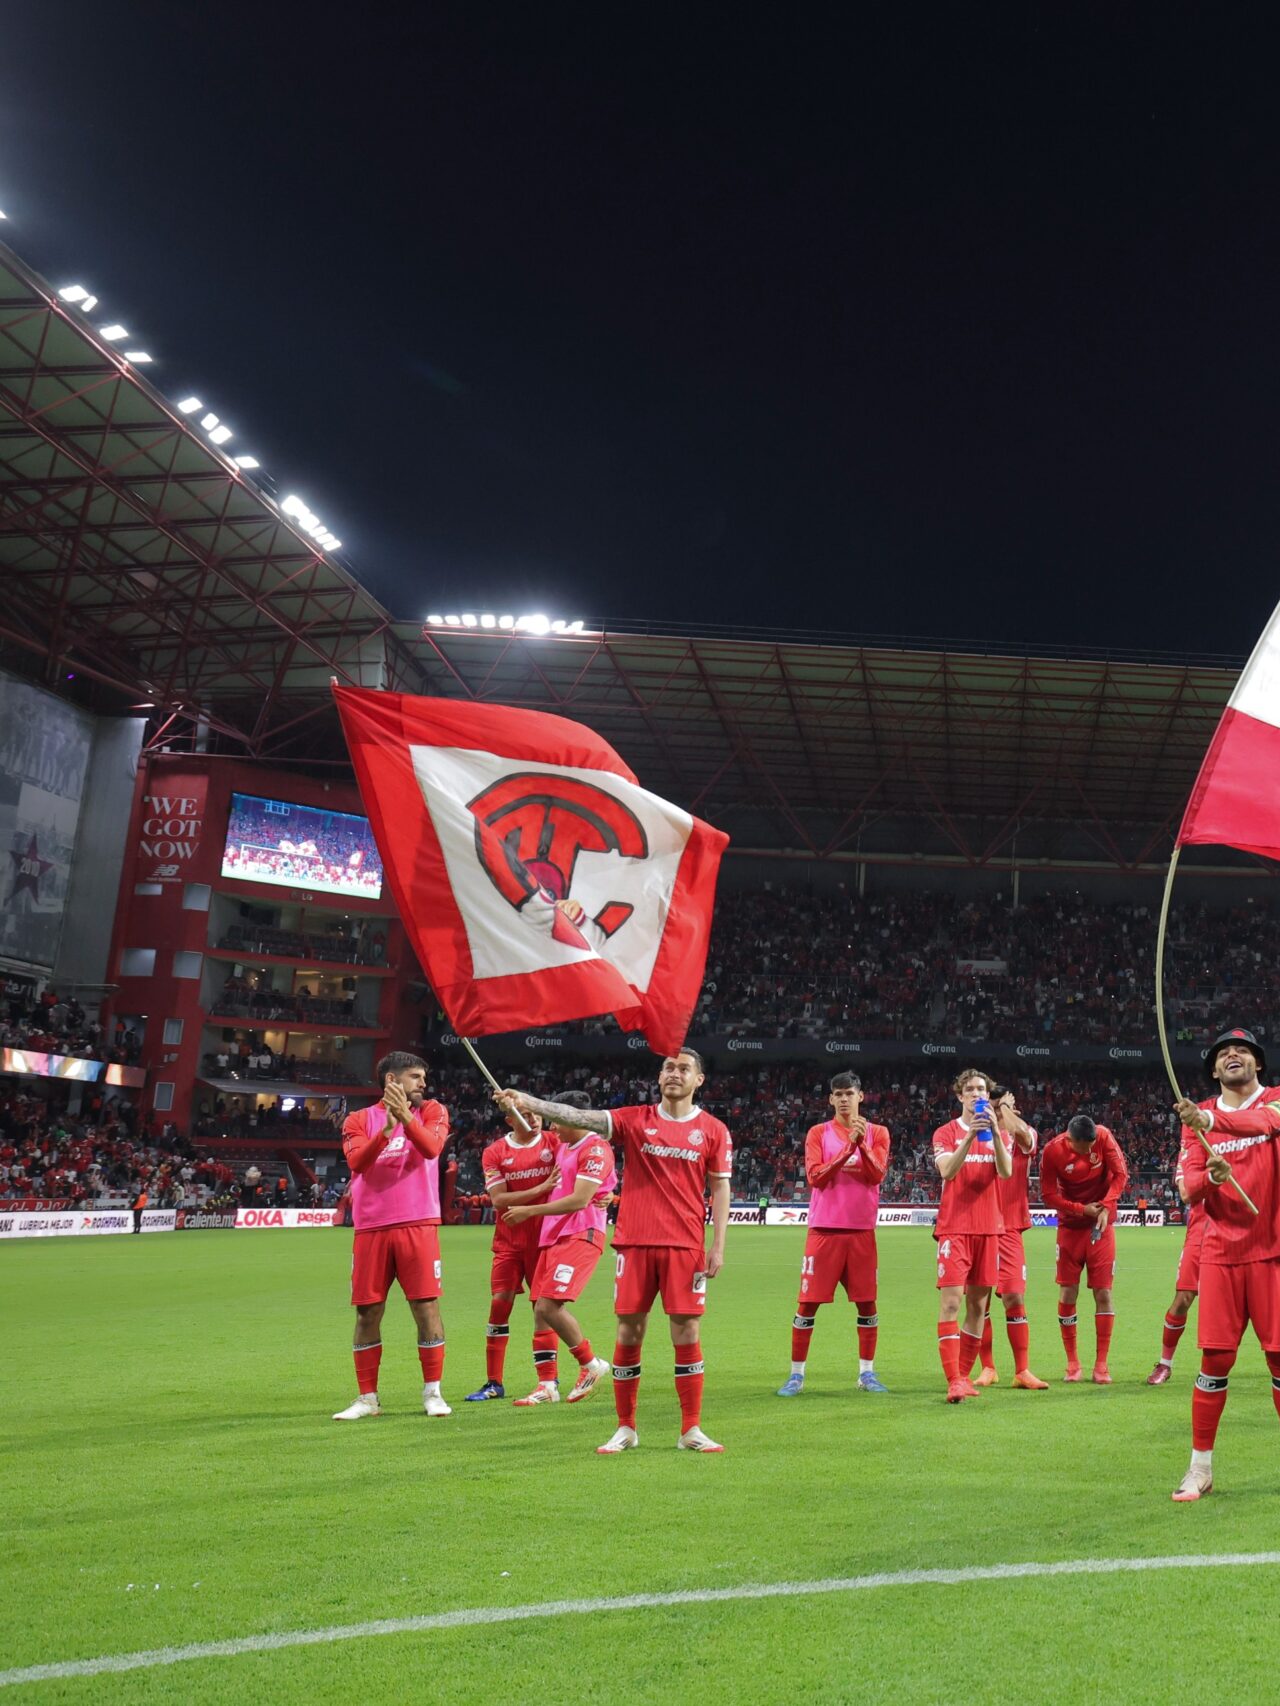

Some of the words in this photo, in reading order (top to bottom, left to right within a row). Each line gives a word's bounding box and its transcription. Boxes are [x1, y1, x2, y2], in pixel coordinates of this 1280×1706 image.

[150, 796, 198, 816] WE
[143, 818, 202, 838] GOT
[139, 841, 200, 859] NOW
[441, 1034, 478, 1046] Corna
[525, 1036, 562, 1048] Corona
[727, 1039, 763, 1051] Corona
[825, 1041, 861, 1053] Corona
[922, 1043, 957, 1055] Corona
[1016, 1045, 1050, 1057] Corona
[1109, 1047, 1142, 1059] Corona
[19, 1220, 49, 1231] LUBRICA
[50, 1219, 74, 1230] MEJOR
[91, 1217, 129, 1229] ROSHFRANS
[184, 1211, 237, 1228] caliente.mx
